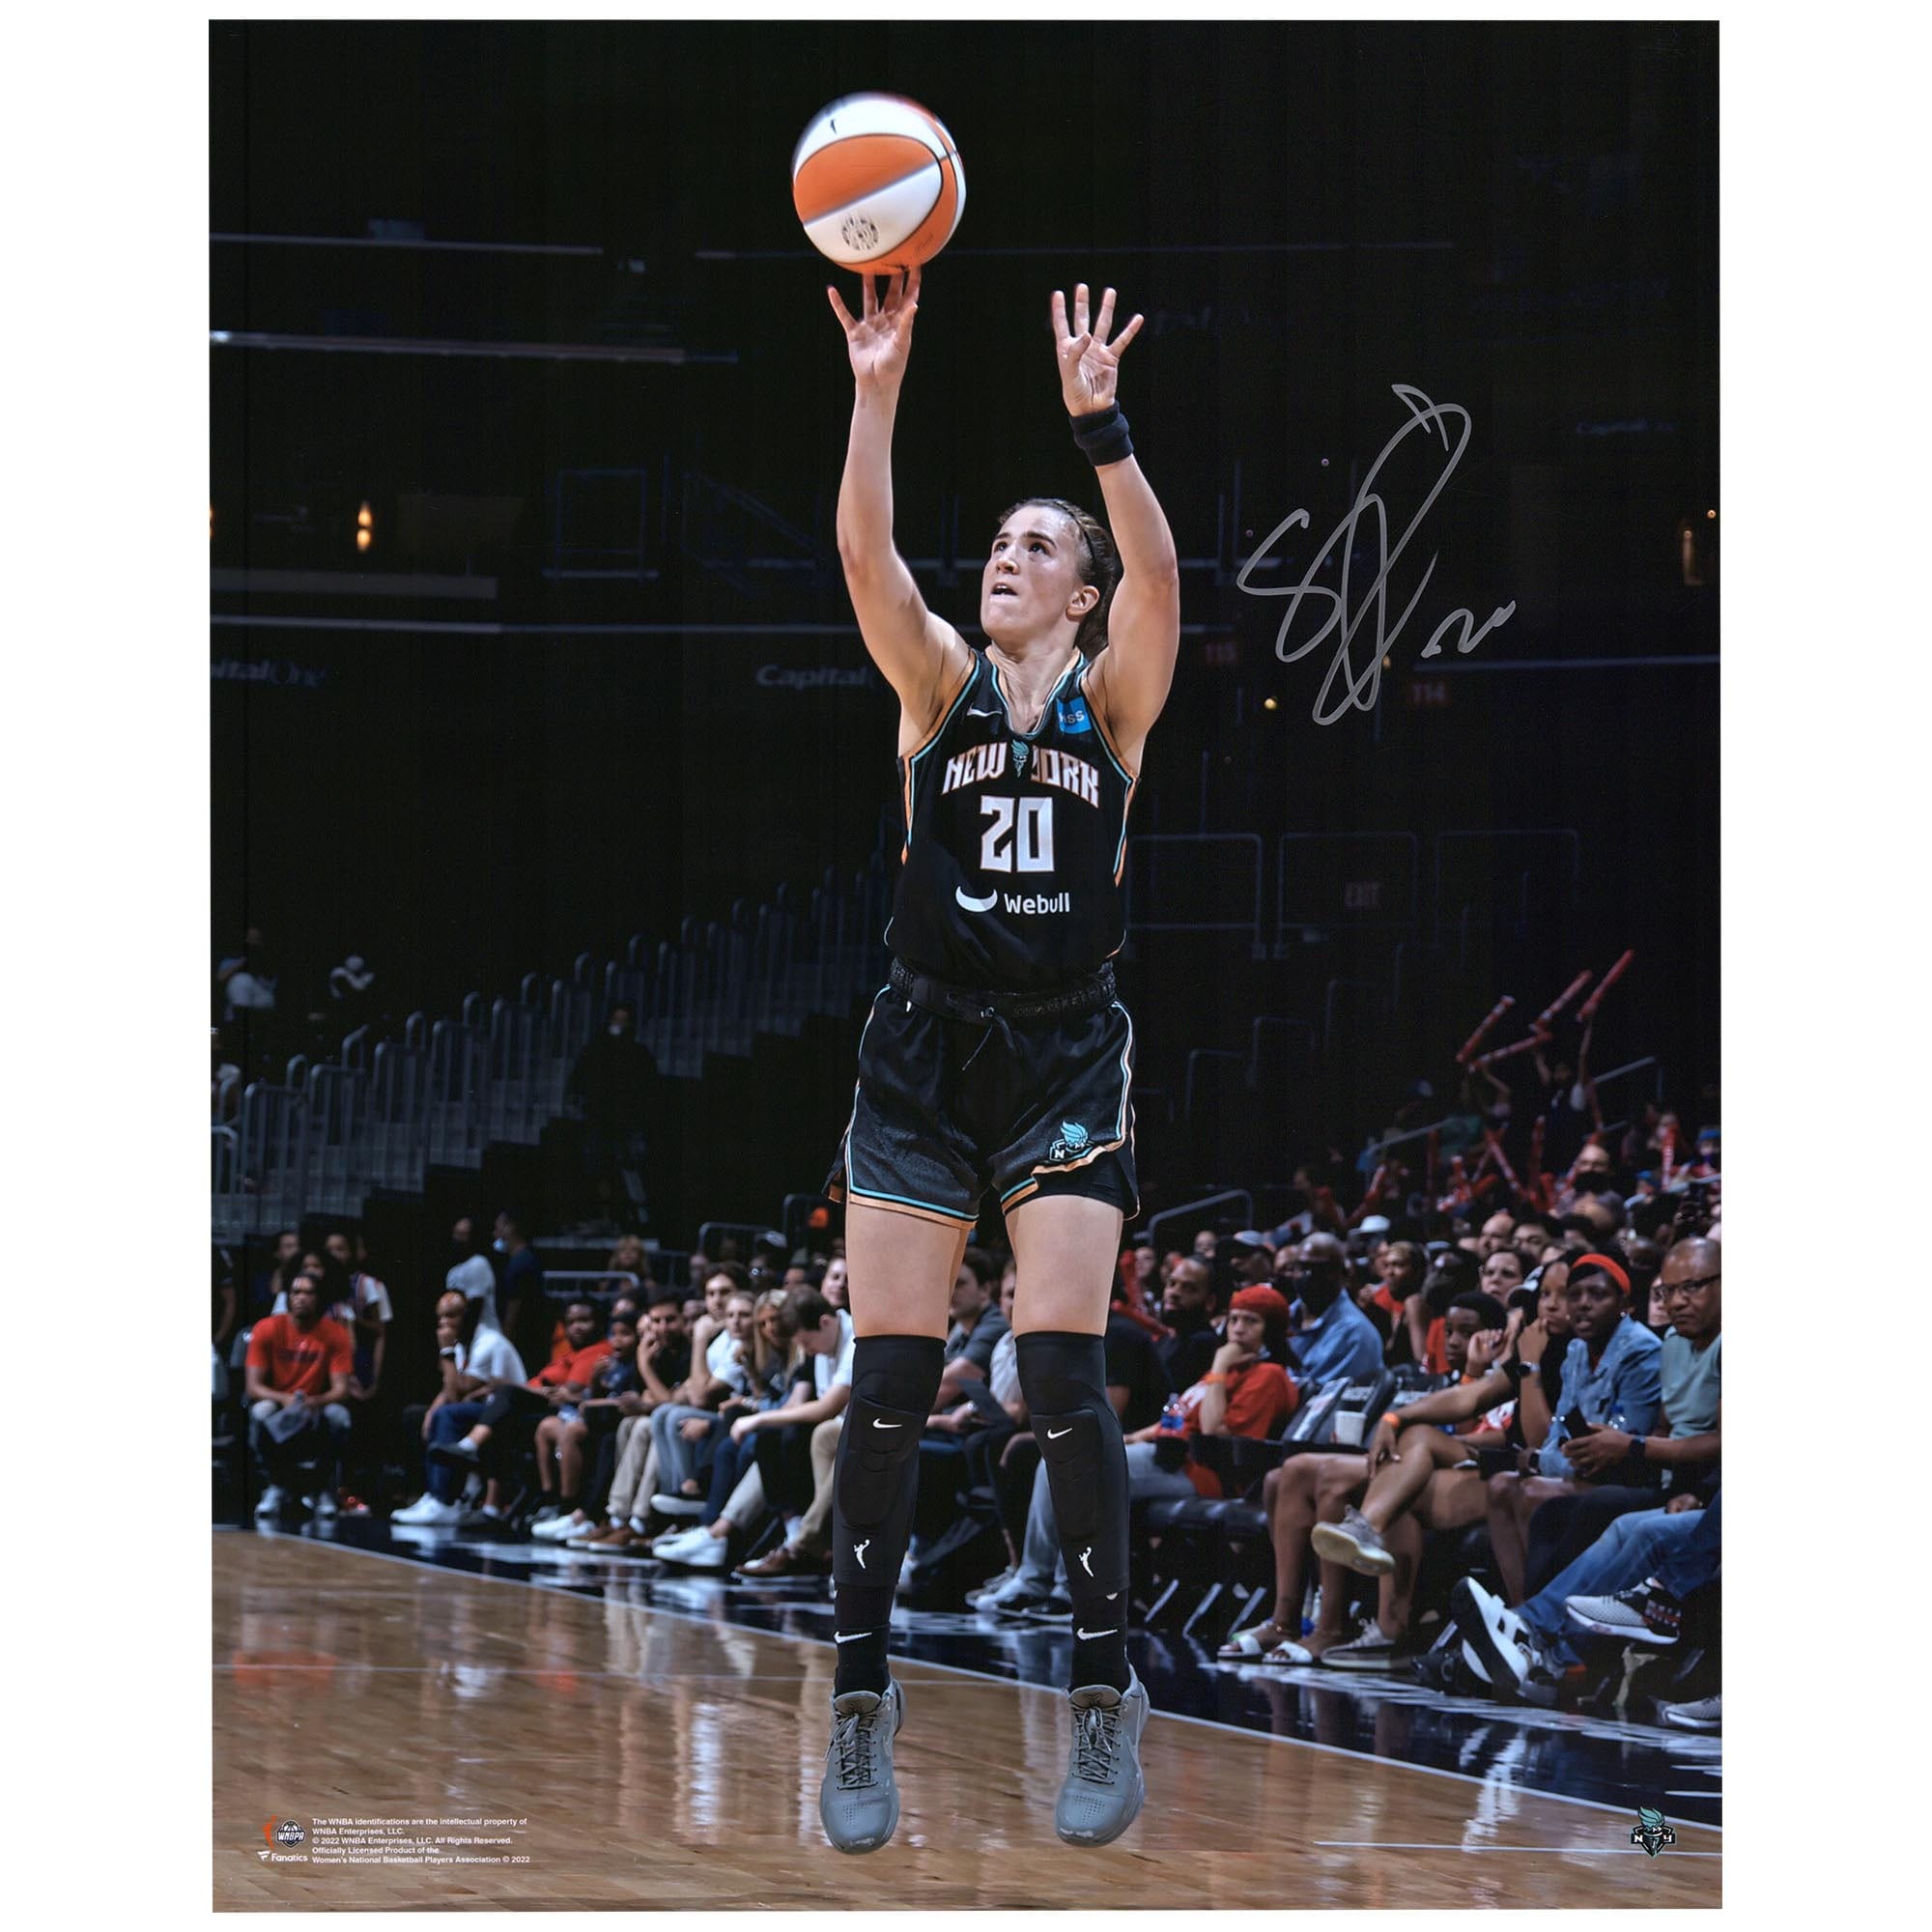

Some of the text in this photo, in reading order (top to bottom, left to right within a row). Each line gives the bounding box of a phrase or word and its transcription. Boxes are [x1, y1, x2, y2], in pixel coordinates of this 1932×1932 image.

[942, 742, 1008, 796] NEW
[980, 795, 1055, 873] 20
[1004, 893, 1070, 914] Webull
